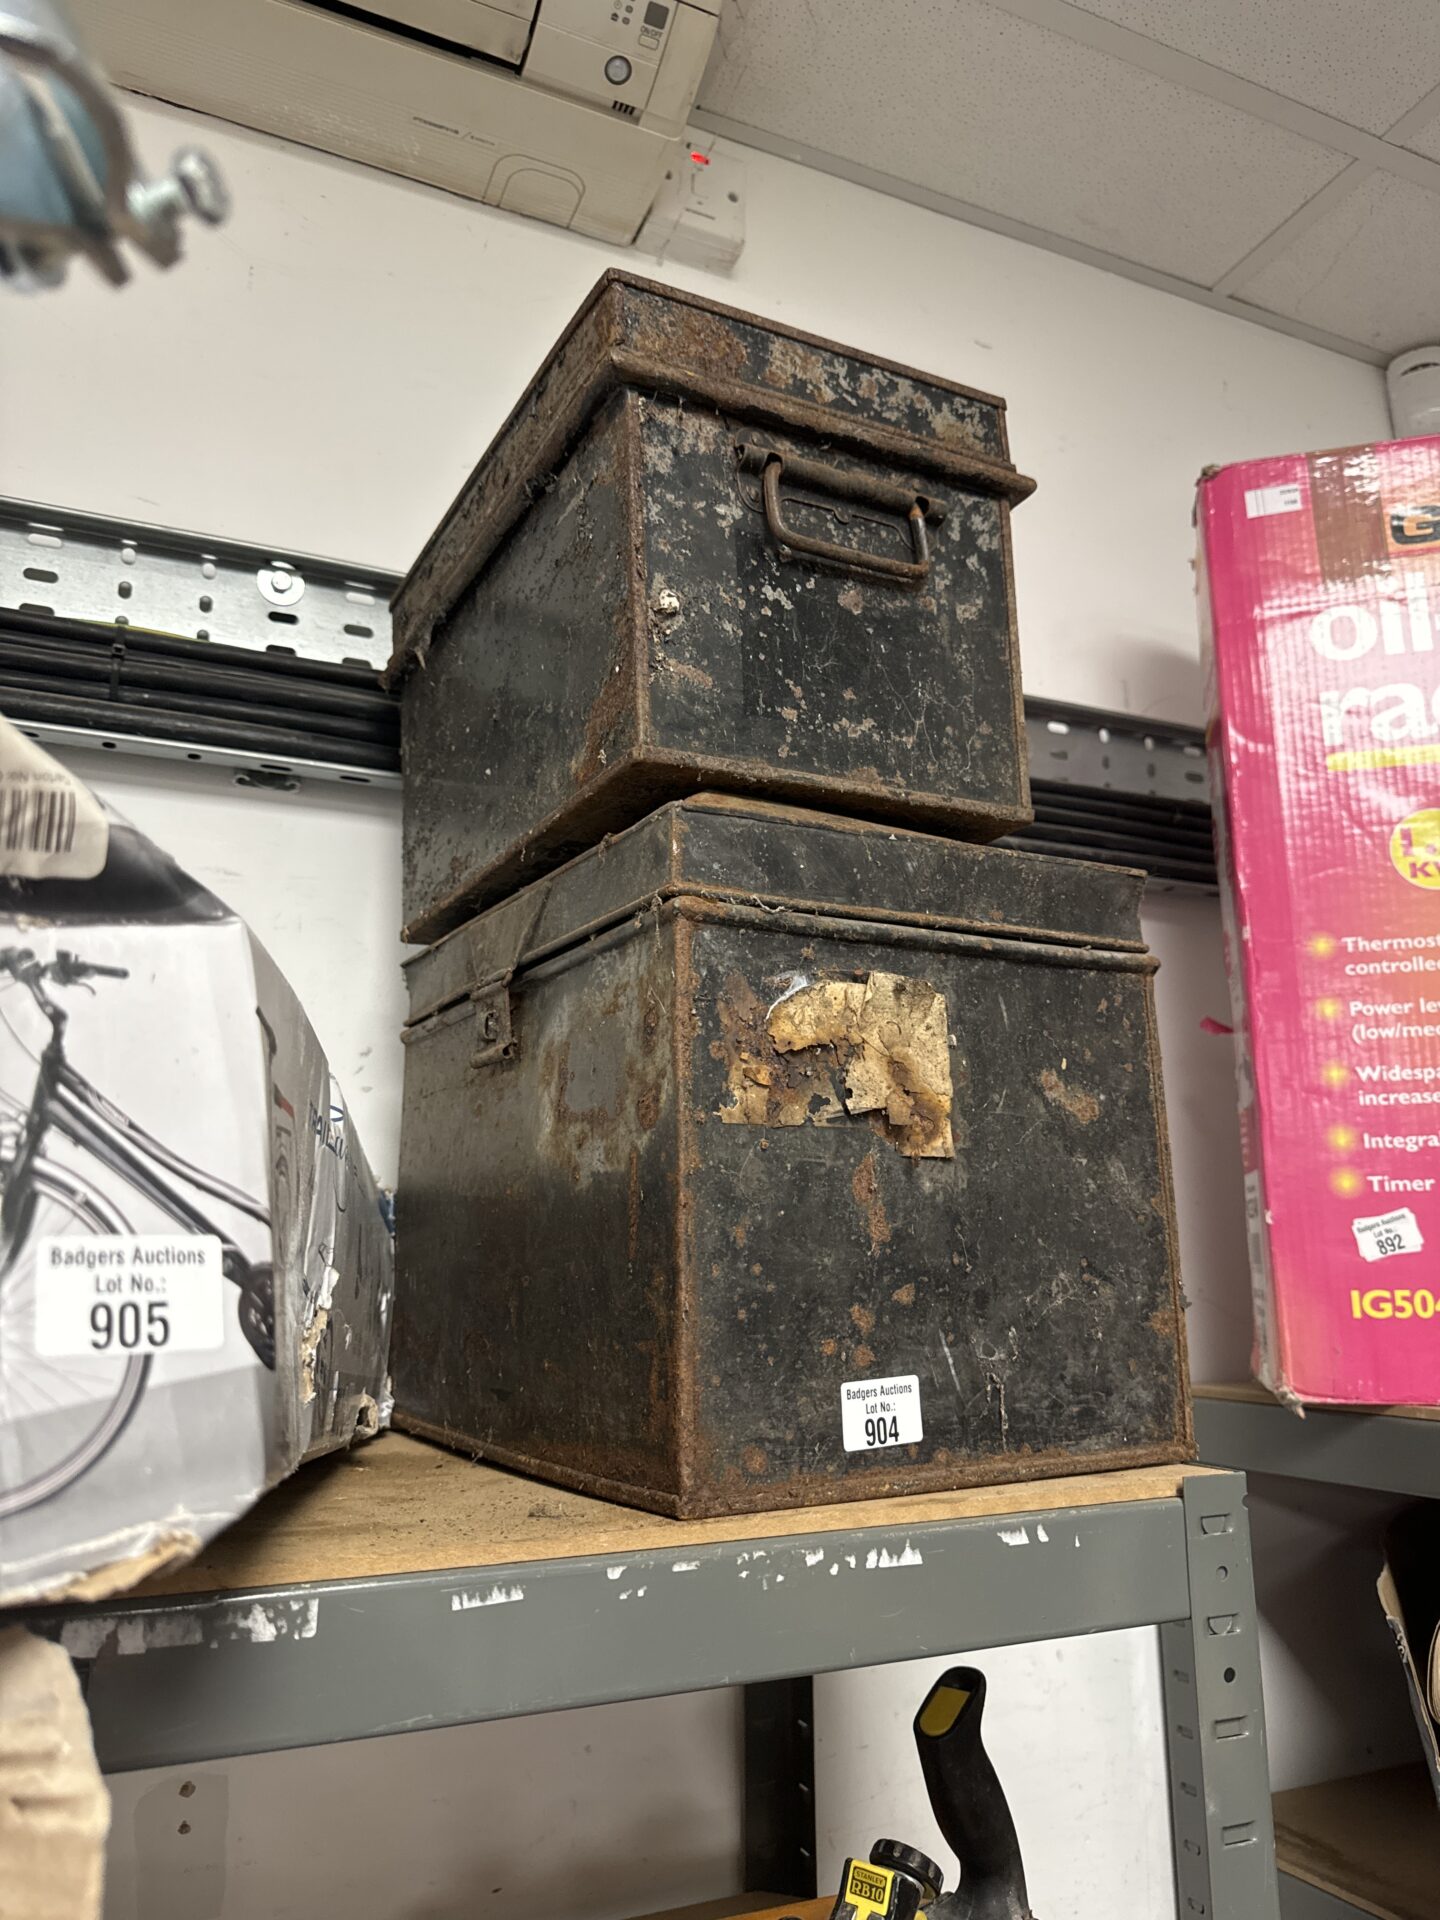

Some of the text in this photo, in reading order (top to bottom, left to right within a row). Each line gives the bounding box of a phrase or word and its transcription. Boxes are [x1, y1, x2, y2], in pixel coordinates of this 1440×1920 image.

[1310, 572, 1440, 661] oil
[1319, 682, 1440, 747] ra
[1349, 997, 1440, 1017] Power le
[1363, 1131, 1440, 1152] Integra
[1366, 1175, 1435, 1193] Timer
[1376, 1234, 1405, 1255] 892
[51, 1246, 206, 1269] Badgers Auctions
[95, 1274, 167, 1293] Lot No.:
[90, 1301, 170, 1350] 905
[846, 1384, 912, 1401] Badgers Auctions
[866, 1401, 896, 1415] Lot No.:
[864, 1415, 900, 1447] 904
[855, 1870, 884, 1885] STANLEY
[851, 1880, 884, 1902] RB10
